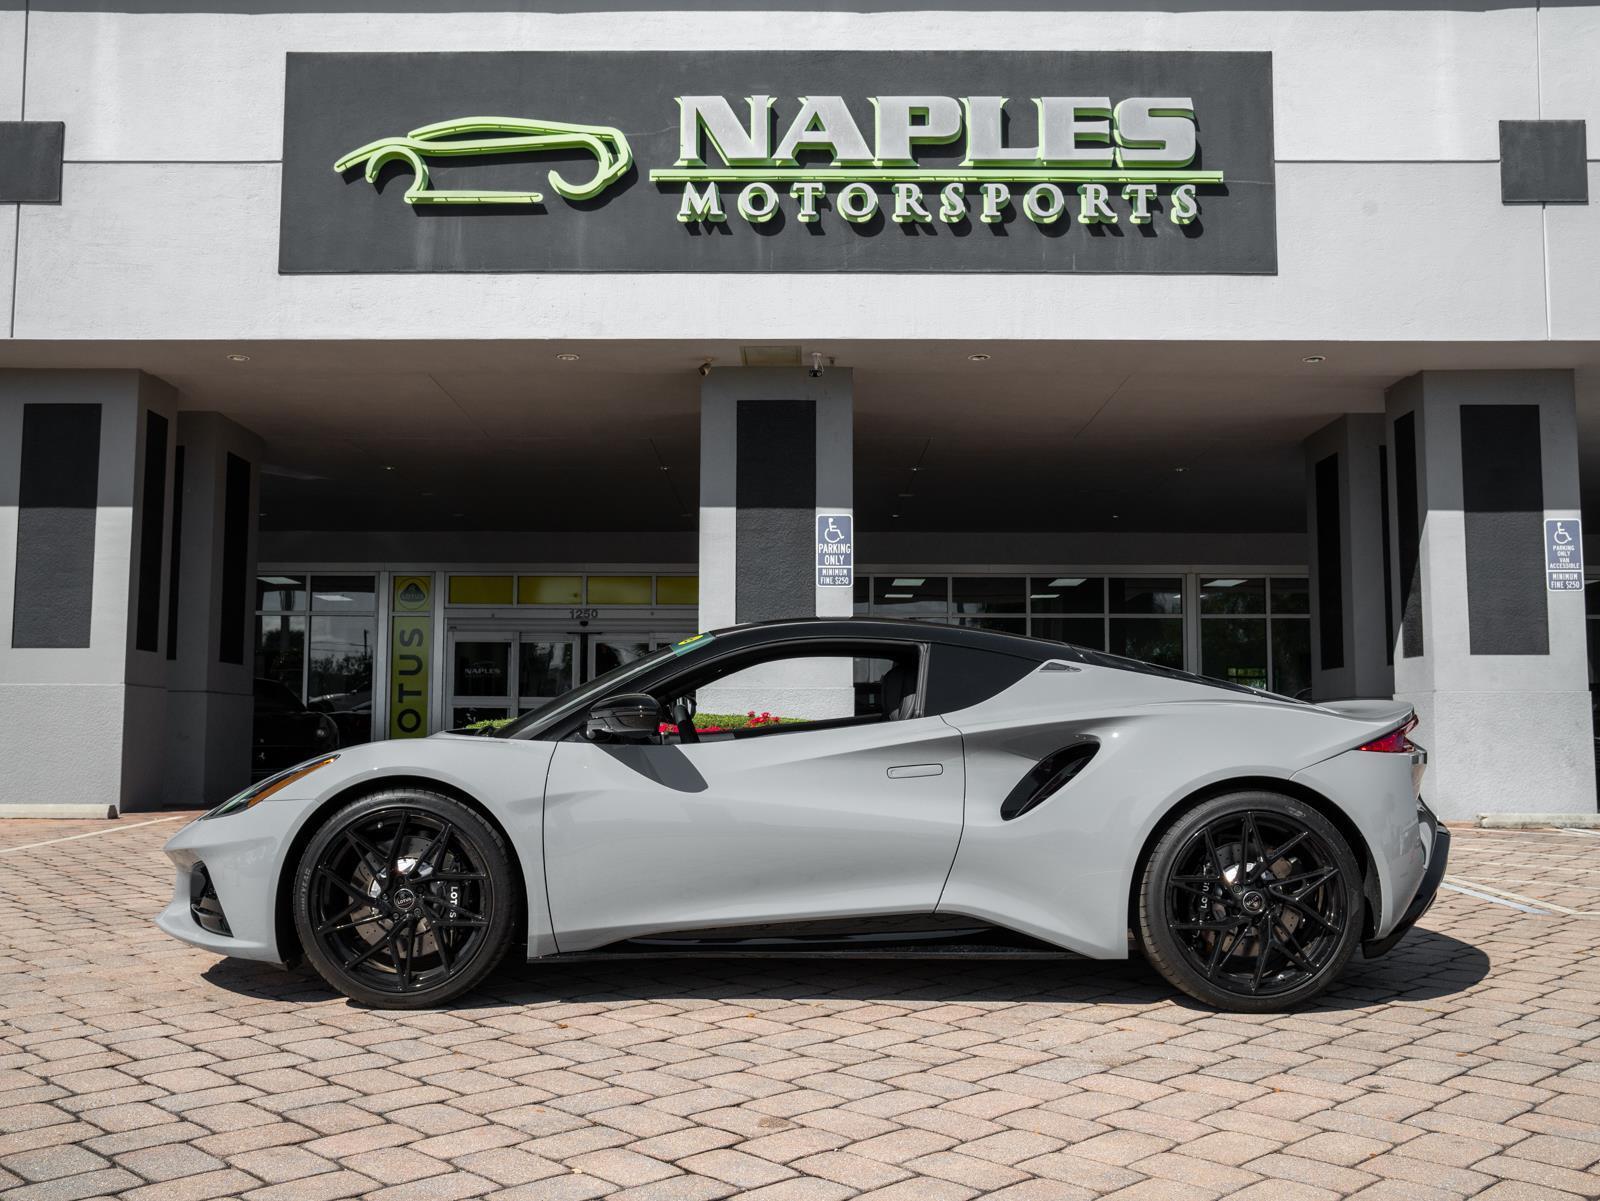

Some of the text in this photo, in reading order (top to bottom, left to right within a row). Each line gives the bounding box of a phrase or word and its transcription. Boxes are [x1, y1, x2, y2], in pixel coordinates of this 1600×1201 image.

[674, 95, 1198, 168] NAPLES
[676, 182, 1199, 224] MOTORSPORTS
[819, 543, 851, 554] PARKING
[824, 555, 845, 565] ONLY
[820, 577, 848, 585] FINE $250
[1551, 581, 1580, 589] FINE $250
[569, 608, 599, 620] 1250
[397, 628, 424, 733] OTUS
[450, 886, 458, 918] LOTS
